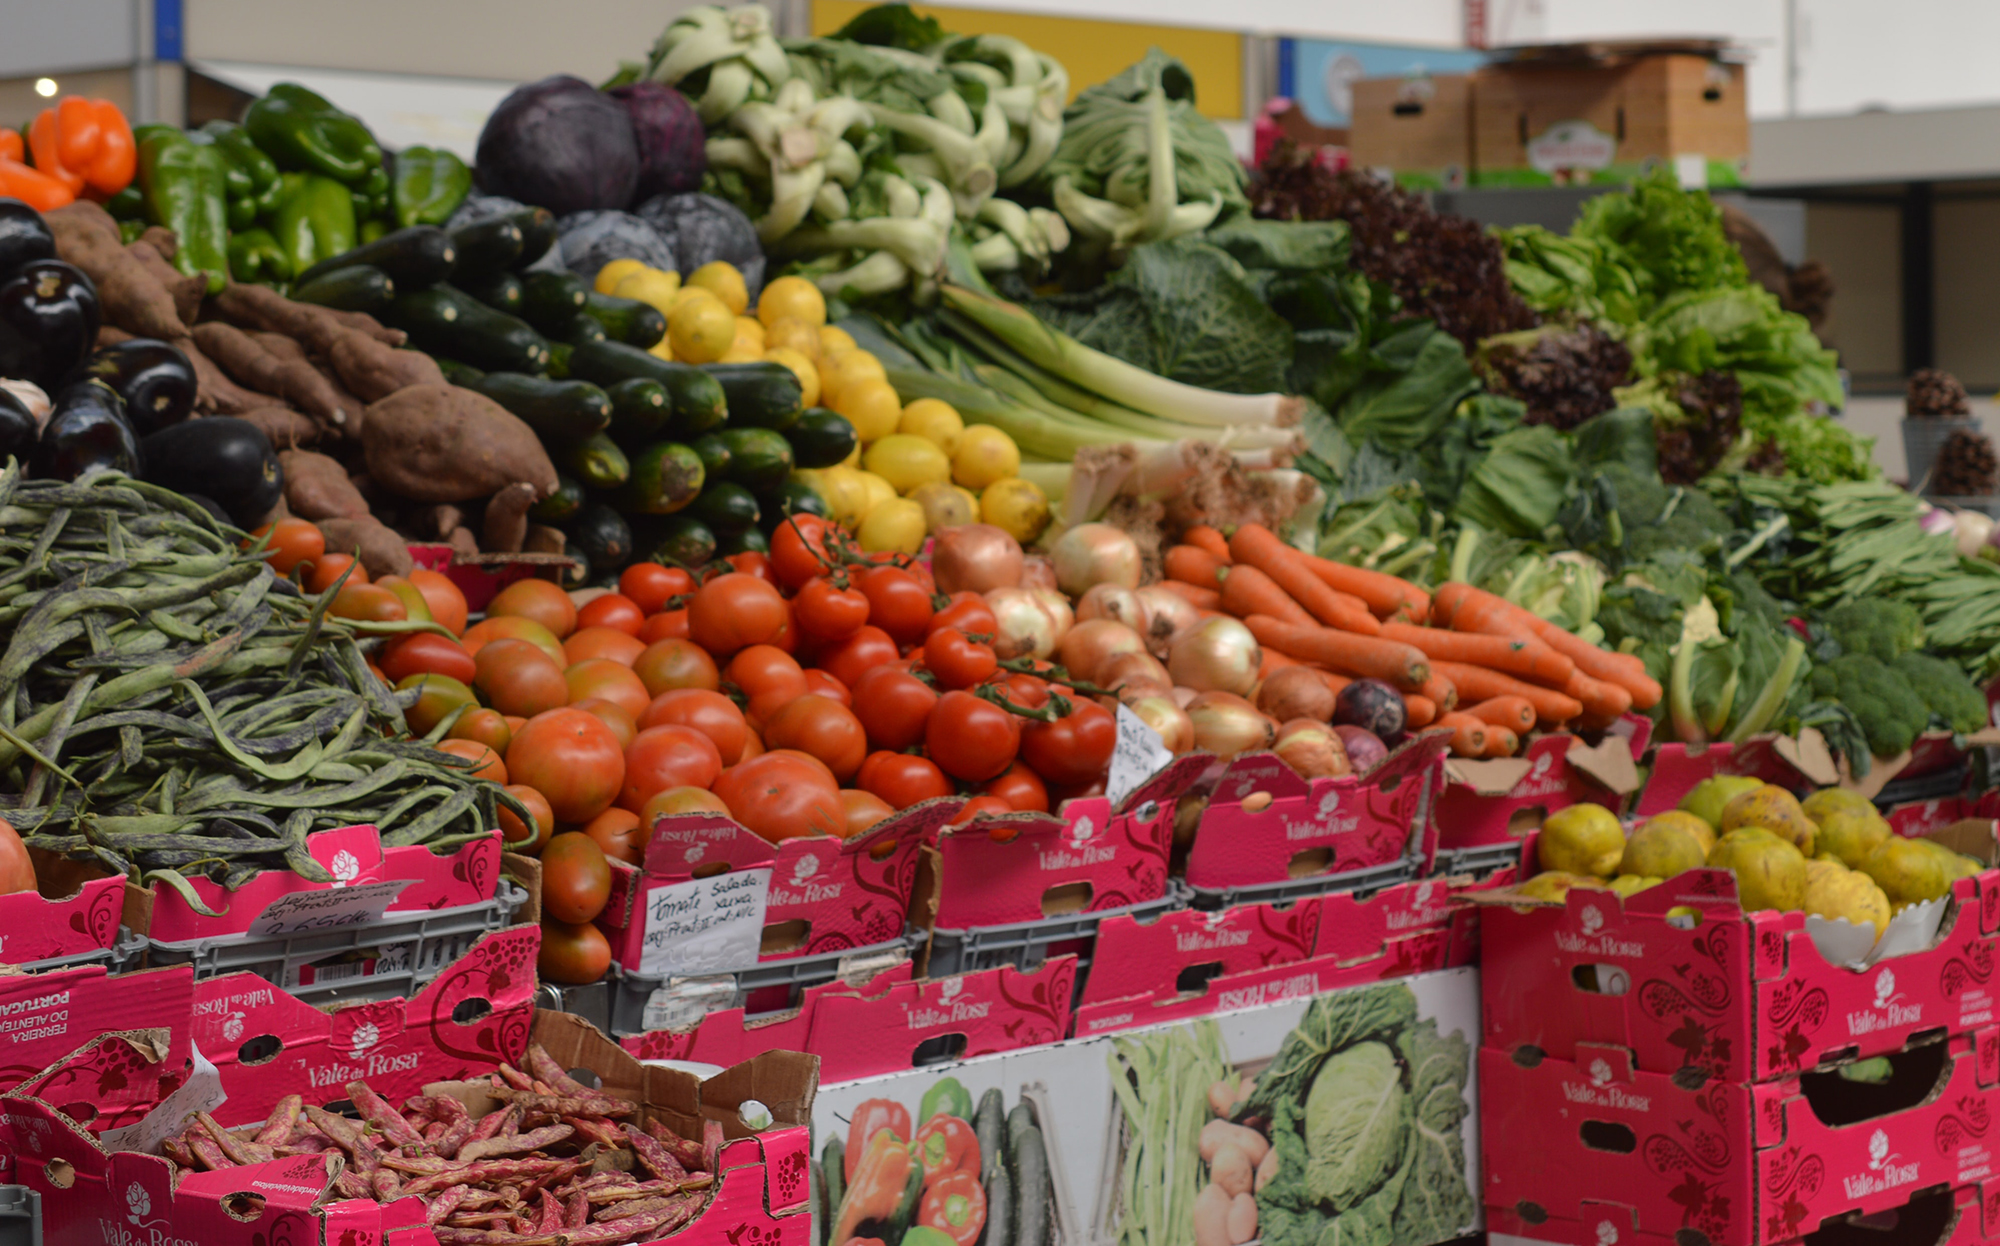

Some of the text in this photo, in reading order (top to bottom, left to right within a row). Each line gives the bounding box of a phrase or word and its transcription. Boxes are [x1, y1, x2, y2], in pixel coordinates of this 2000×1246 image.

[1039, 850, 1071, 871] Vale
[1082, 845, 1117, 866] Rosa
[766, 886, 789, 906] ale
[803, 883, 843, 903] Rosa
[1177, 931, 1205, 952] Vale
[1214, 928, 1249, 947] Rosa
[1553, 930, 1587, 953] Vale
[1601, 936, 1643, 958] Rosa
[1219, 984, 1266, 1010] Rosa
[1282, 972, 1320, 1000] Vale
[50, 1010, 69, 1022] DO
[192, 988, 275, 1016] Vale da Rosa
[907, 1007, 939, 1029] Vale
[951, 1001, 990, 1022] Rosa
[12, 1023, 67, 1043] FERREIRA
[1846, 1009, 1877, 1036] Vale
[1887, 1002, 1922, 1028] Rosa
[308, 1052, 419, 1088] Vale da Rosa
[1562, 1080, 1596, 1104] Vale
[1609, 1087, 1651, 1112] Rosa
[1843, 1162, 1919, 1200] Vale da Rosa
[99, 1218, 132, 1246] Vale
